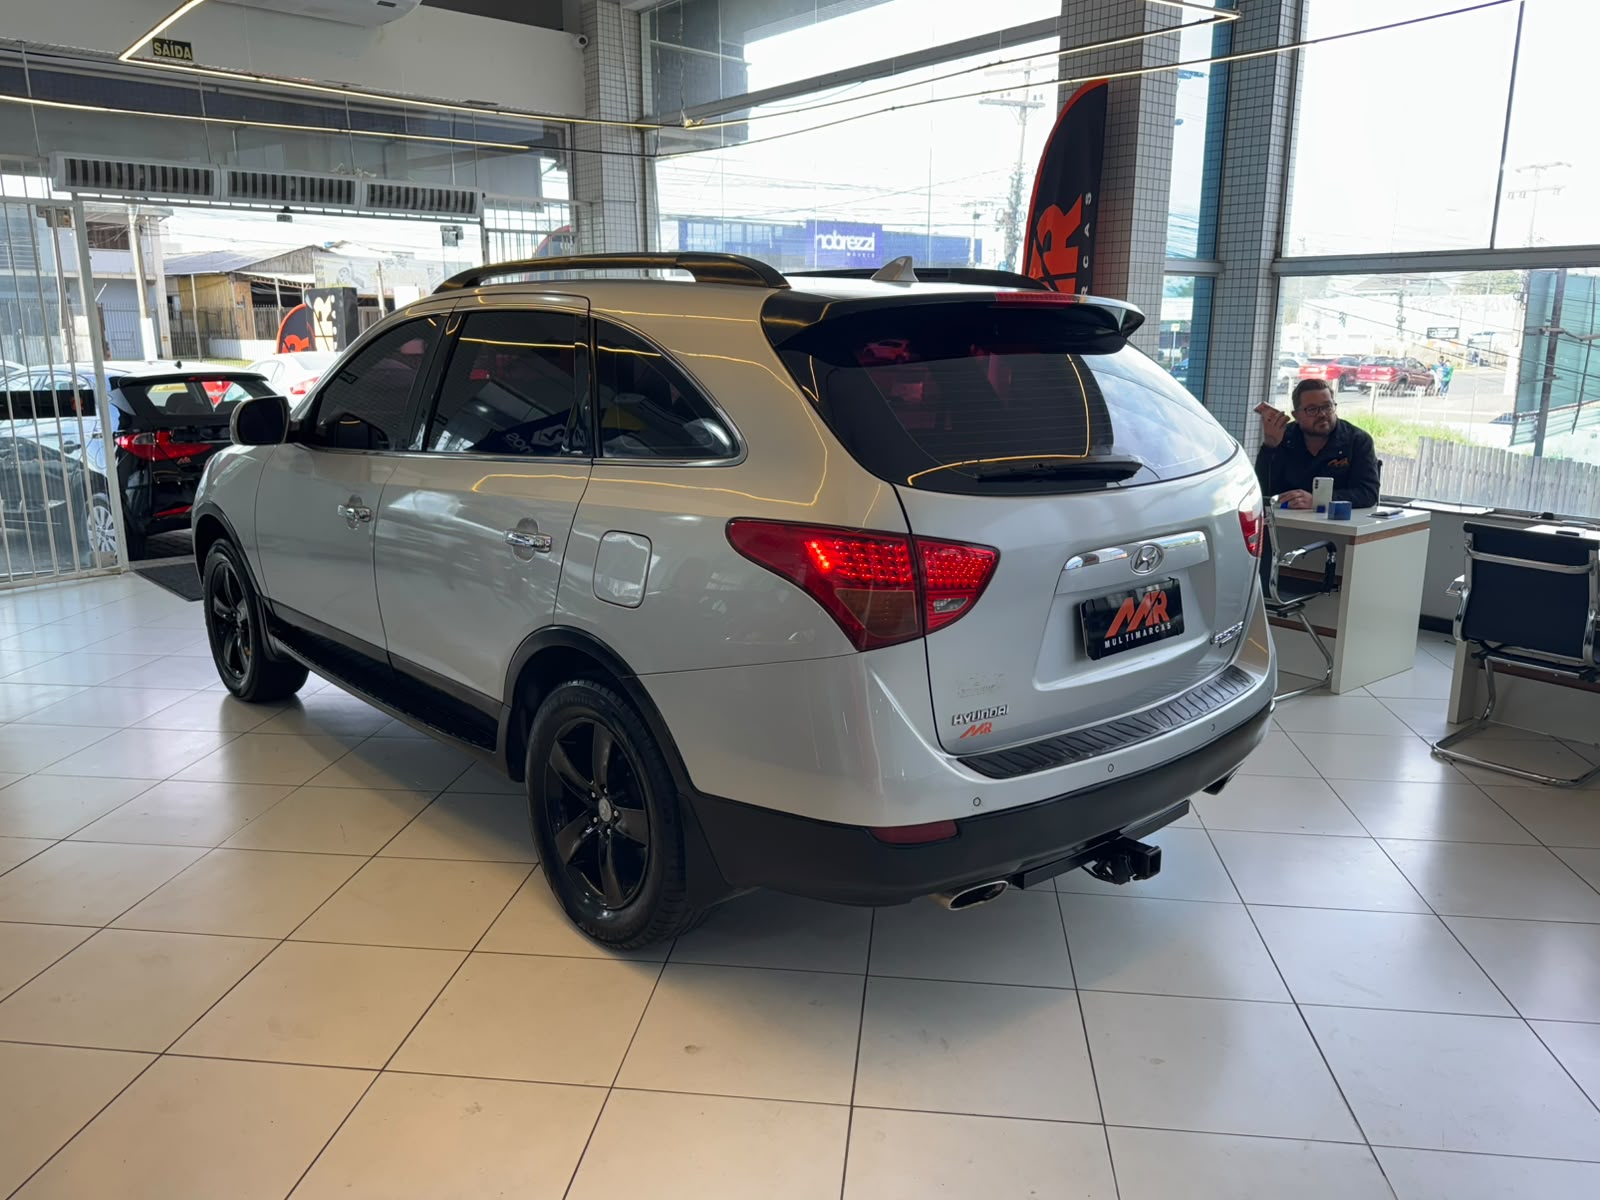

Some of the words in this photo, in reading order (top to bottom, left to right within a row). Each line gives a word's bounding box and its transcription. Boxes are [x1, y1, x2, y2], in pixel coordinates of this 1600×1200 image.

[153, 40, 192, 60] SAÍDA
[815, 228, 876, 252] nobrezzi
[1104, 621, 1172, 649] MULTIMARCAS
[951, 703, 1009, 726] HYUNDAI
